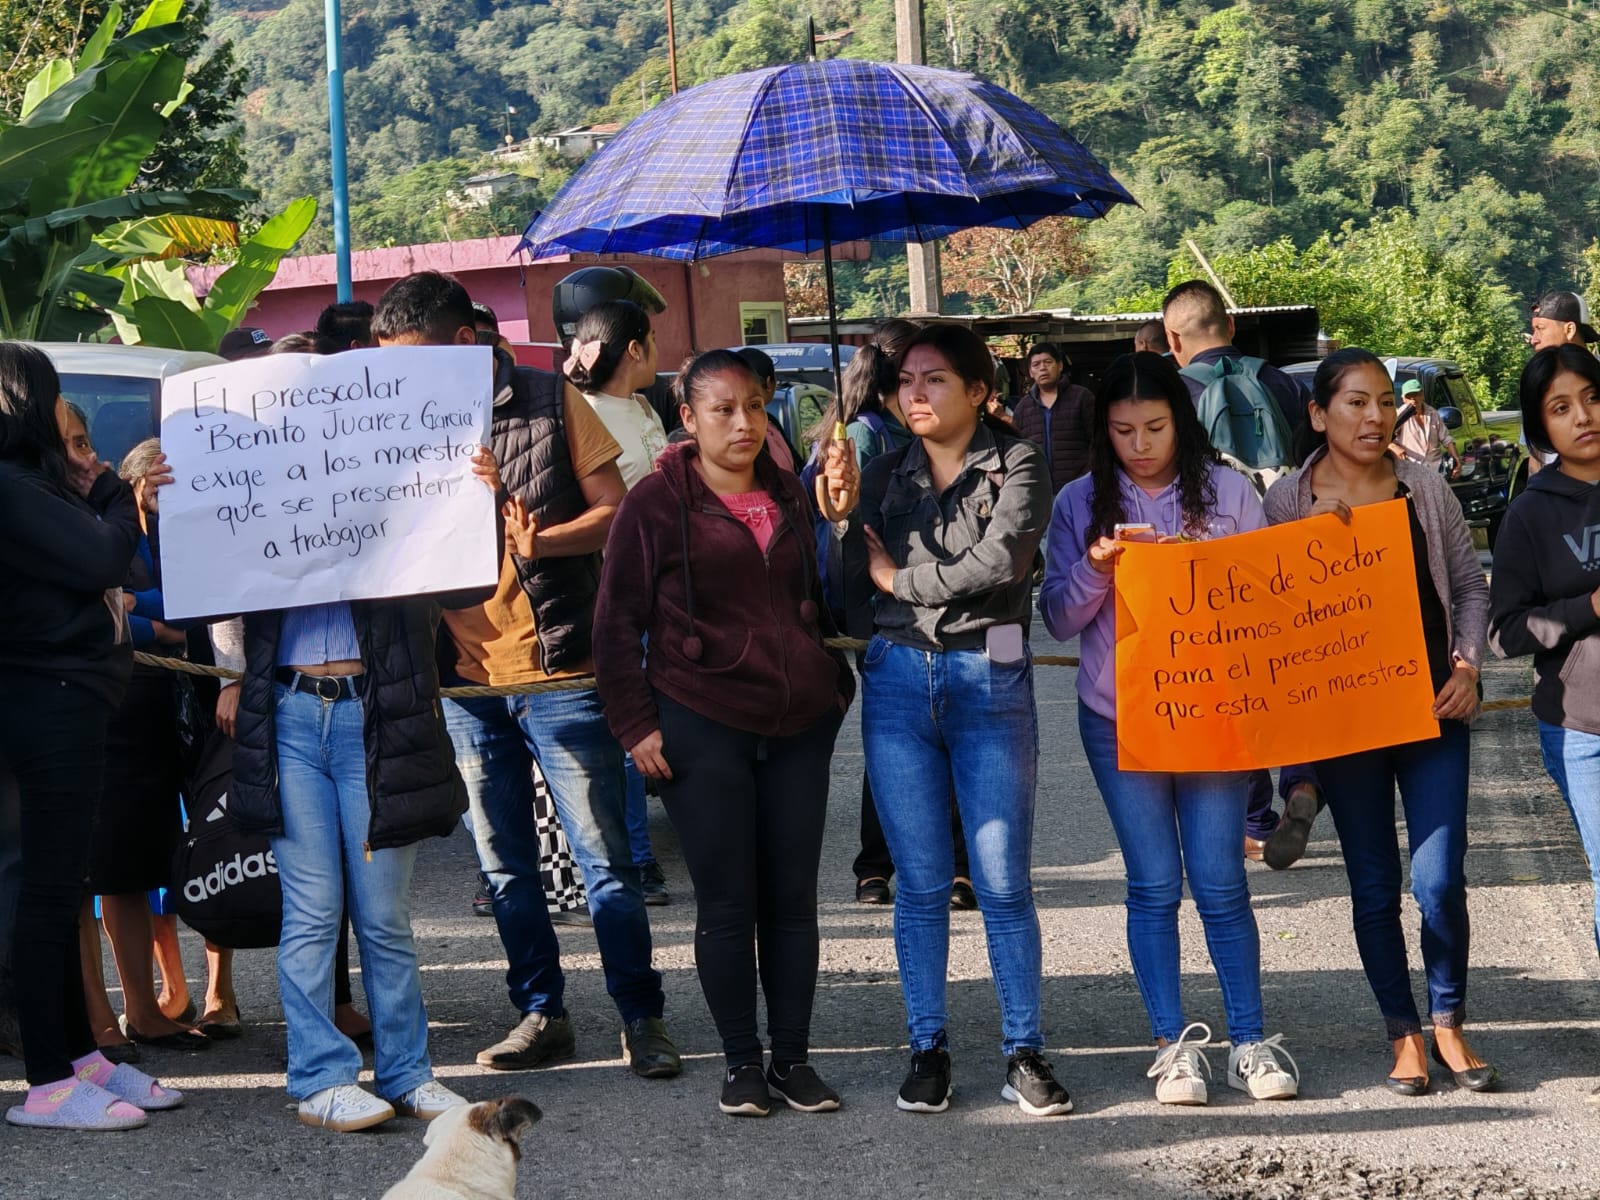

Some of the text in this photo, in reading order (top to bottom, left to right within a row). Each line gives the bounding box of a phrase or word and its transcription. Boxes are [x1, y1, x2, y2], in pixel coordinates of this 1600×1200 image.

[193, 366, 407, 422] El preescolar
[322, 408, 410, 440] Juarez
[191, 436, 482, 503] exige a los maestro
[217, 472, 452, 535] que se presenten
[263, 517, 389, 559] a trabajar
[1168, 536, 1389, 616] Jefe de Sector
[1170, 587, 1372, 658] pedimos atención
[1153, 629, 1371, 692] para el preescolar
[1155, 659, 1419, 730] que esta sin maestros
[183, 849, 278, 903] adidas
